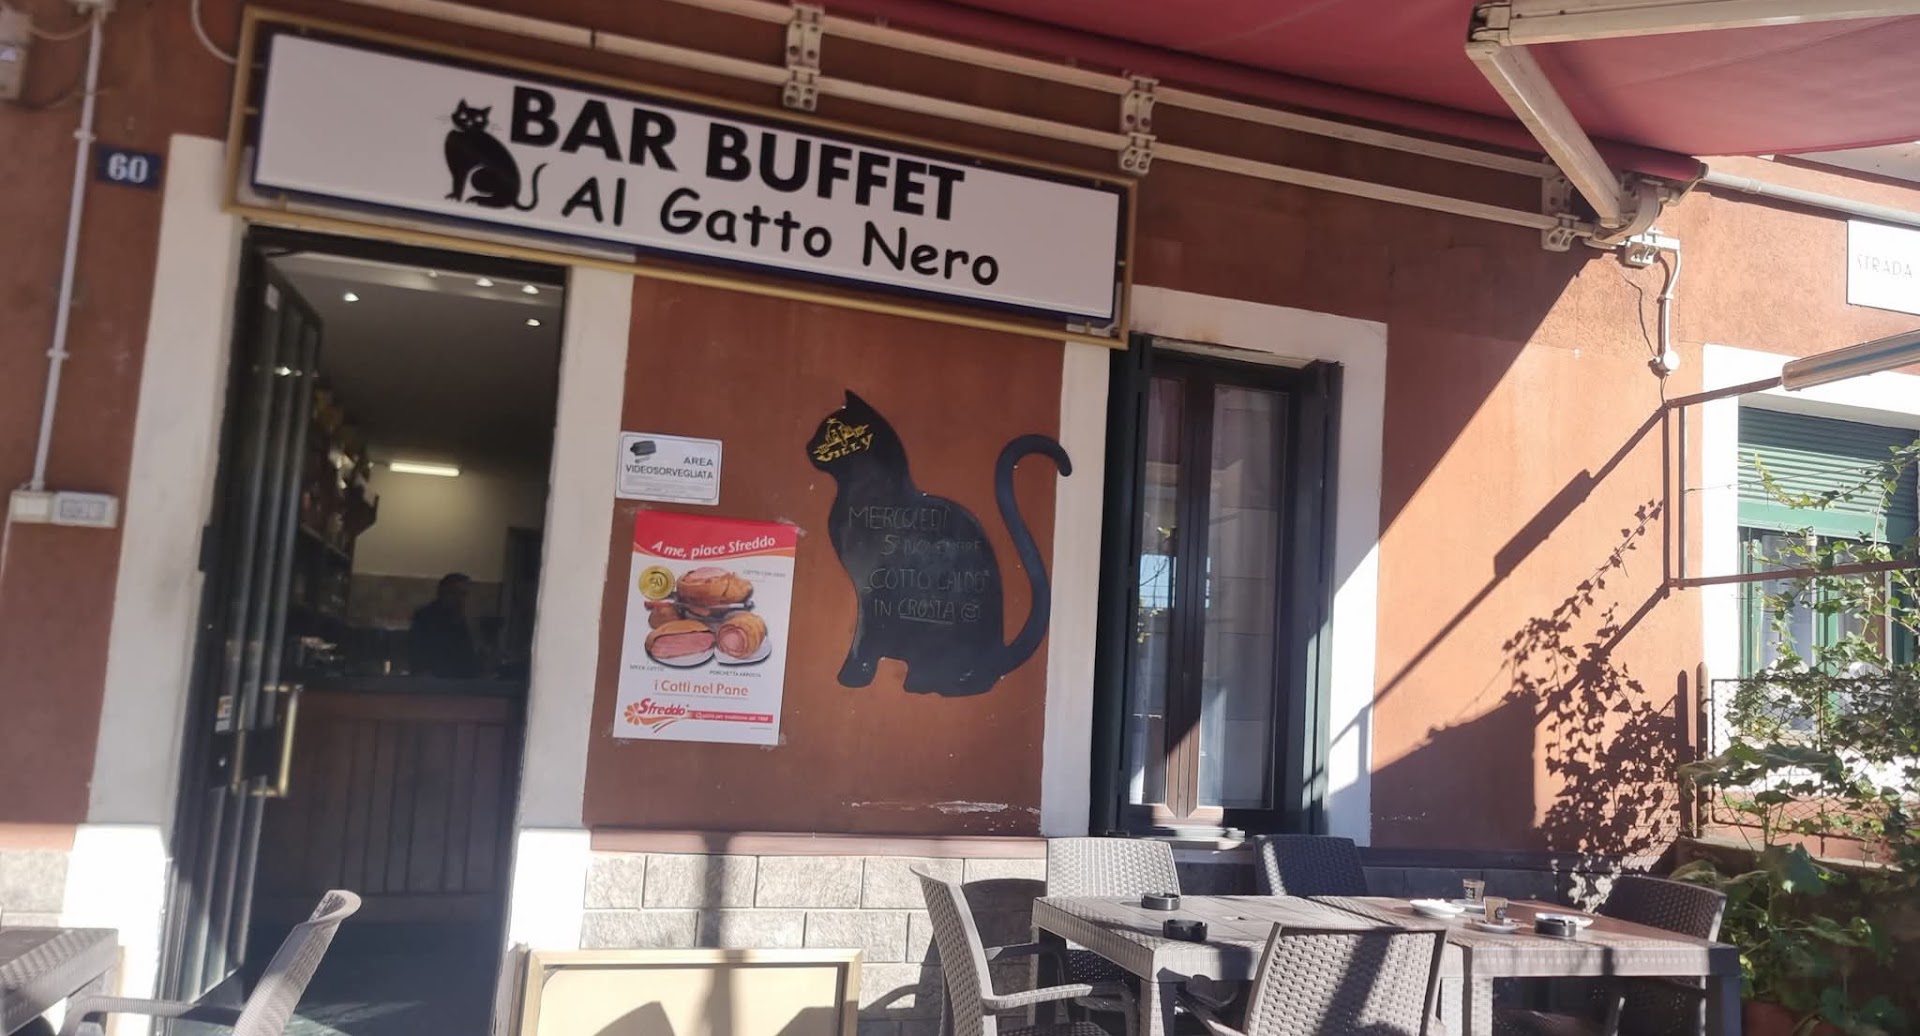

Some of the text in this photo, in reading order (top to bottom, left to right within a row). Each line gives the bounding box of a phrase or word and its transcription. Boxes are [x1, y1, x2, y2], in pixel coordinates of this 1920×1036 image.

[511, 86, 965, 221] BAR BUFFET
[108, 152, 148, 184] 60
[561, 176, 998, 286] Al Gatto Nero
[1857, 253, 1913, 279] STRADA
[625, 464, 714, 479] VIDEOSORVEGLIATA
[683, 456, 714, 467] AREA
[652, 535, 776, 560] A me, piace Sfreddo
[880, 534, 900, 555] 5
[874, 598, 892, 617] IN
[661, 680, 690, 692] Cotti
[693, 682, 713, 694] nel
[716, 683, 749, 697] Pane
[638, 698, 686, 716] Sfreddo
